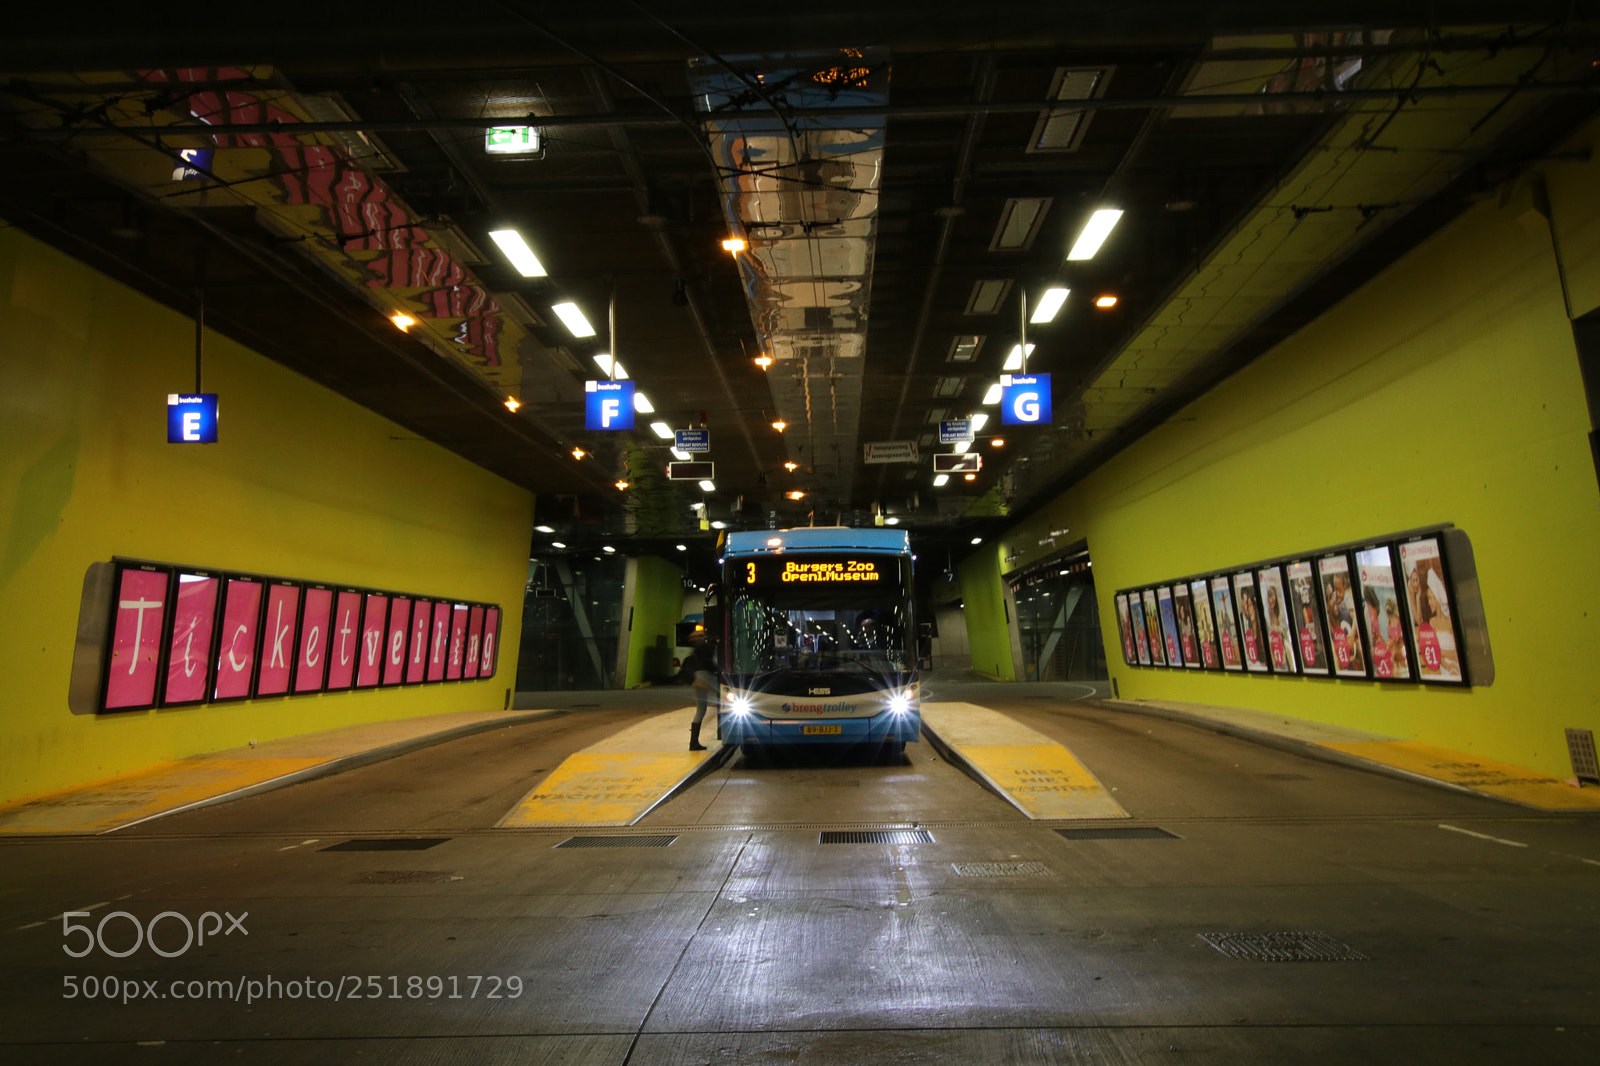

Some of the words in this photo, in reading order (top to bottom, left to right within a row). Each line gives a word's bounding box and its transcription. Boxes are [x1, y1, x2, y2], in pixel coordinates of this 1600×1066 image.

[602, 399, 620, 428] F
[1014, 392, 1039, 422] G
[183, 412, 201, 441] E
[746, 562, 756, 584] 3
[786, 562, 843, 572] Burgers
[847, 561, 875, 572] Zoo
[683, 579, 693, 588] 10
[1339, 646, 1349, 662] €1
[1425, 646, 1439, 665] €1
[793, 701, 858, 715] brengtrolley
